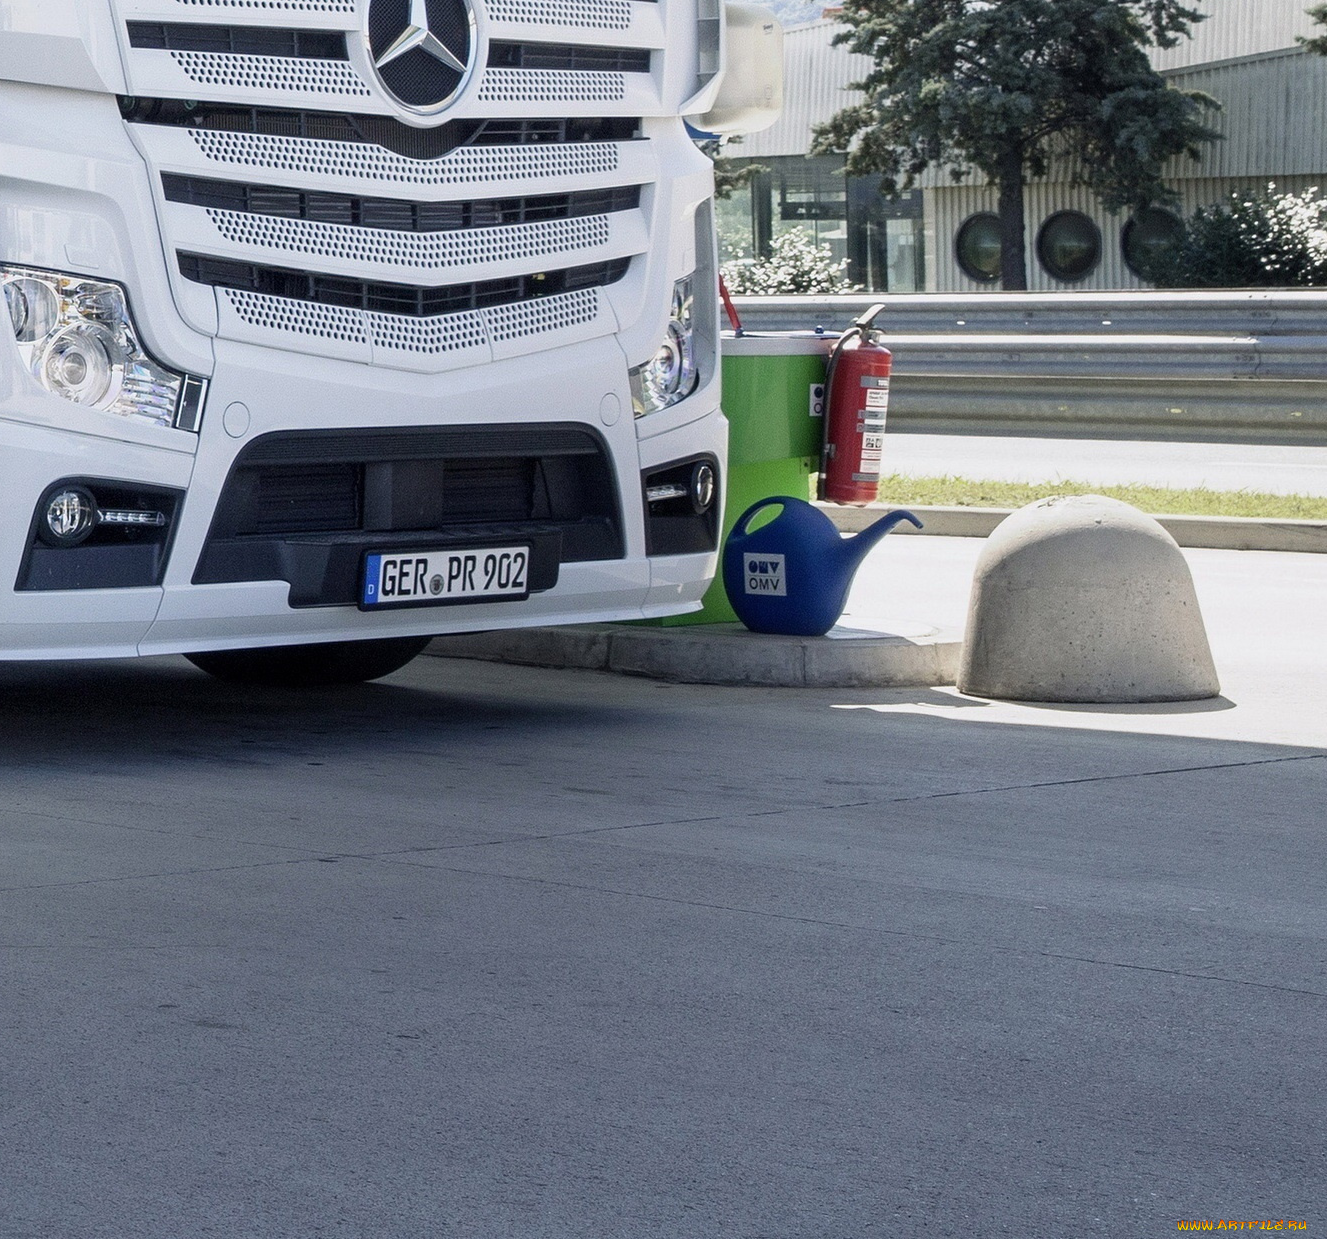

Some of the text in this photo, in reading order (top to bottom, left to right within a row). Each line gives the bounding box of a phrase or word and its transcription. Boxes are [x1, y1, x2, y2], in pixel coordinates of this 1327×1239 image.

[381, 552, 526, 596] GER PR 902
[367, 584, 375, 595] D
[748, 577, 780, 591] OMV
